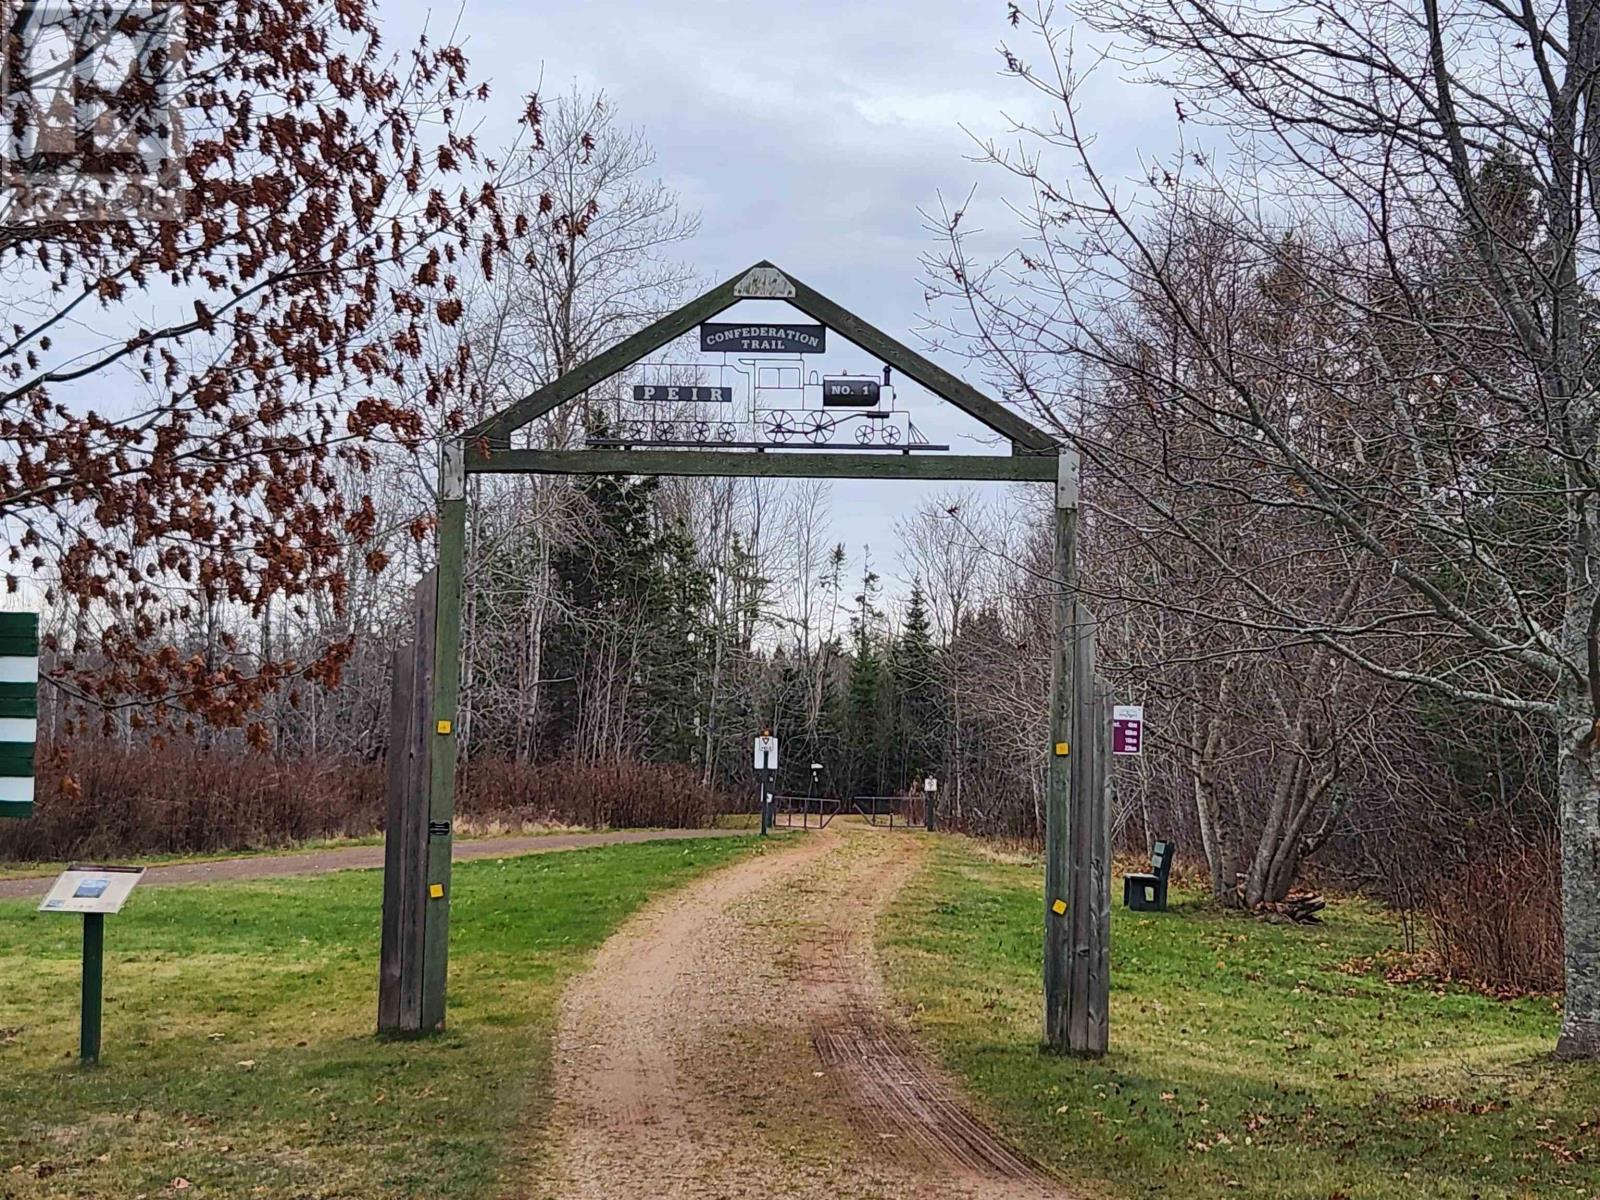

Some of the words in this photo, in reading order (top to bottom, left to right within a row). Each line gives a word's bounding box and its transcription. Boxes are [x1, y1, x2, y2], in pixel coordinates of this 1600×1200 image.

[706, 327, 820, 347] CONFEDERATION
[741, 339, 785, 349] TRAIL
[831, 385, 854, 395] NO.
[862, 386, 869, 395] 1
